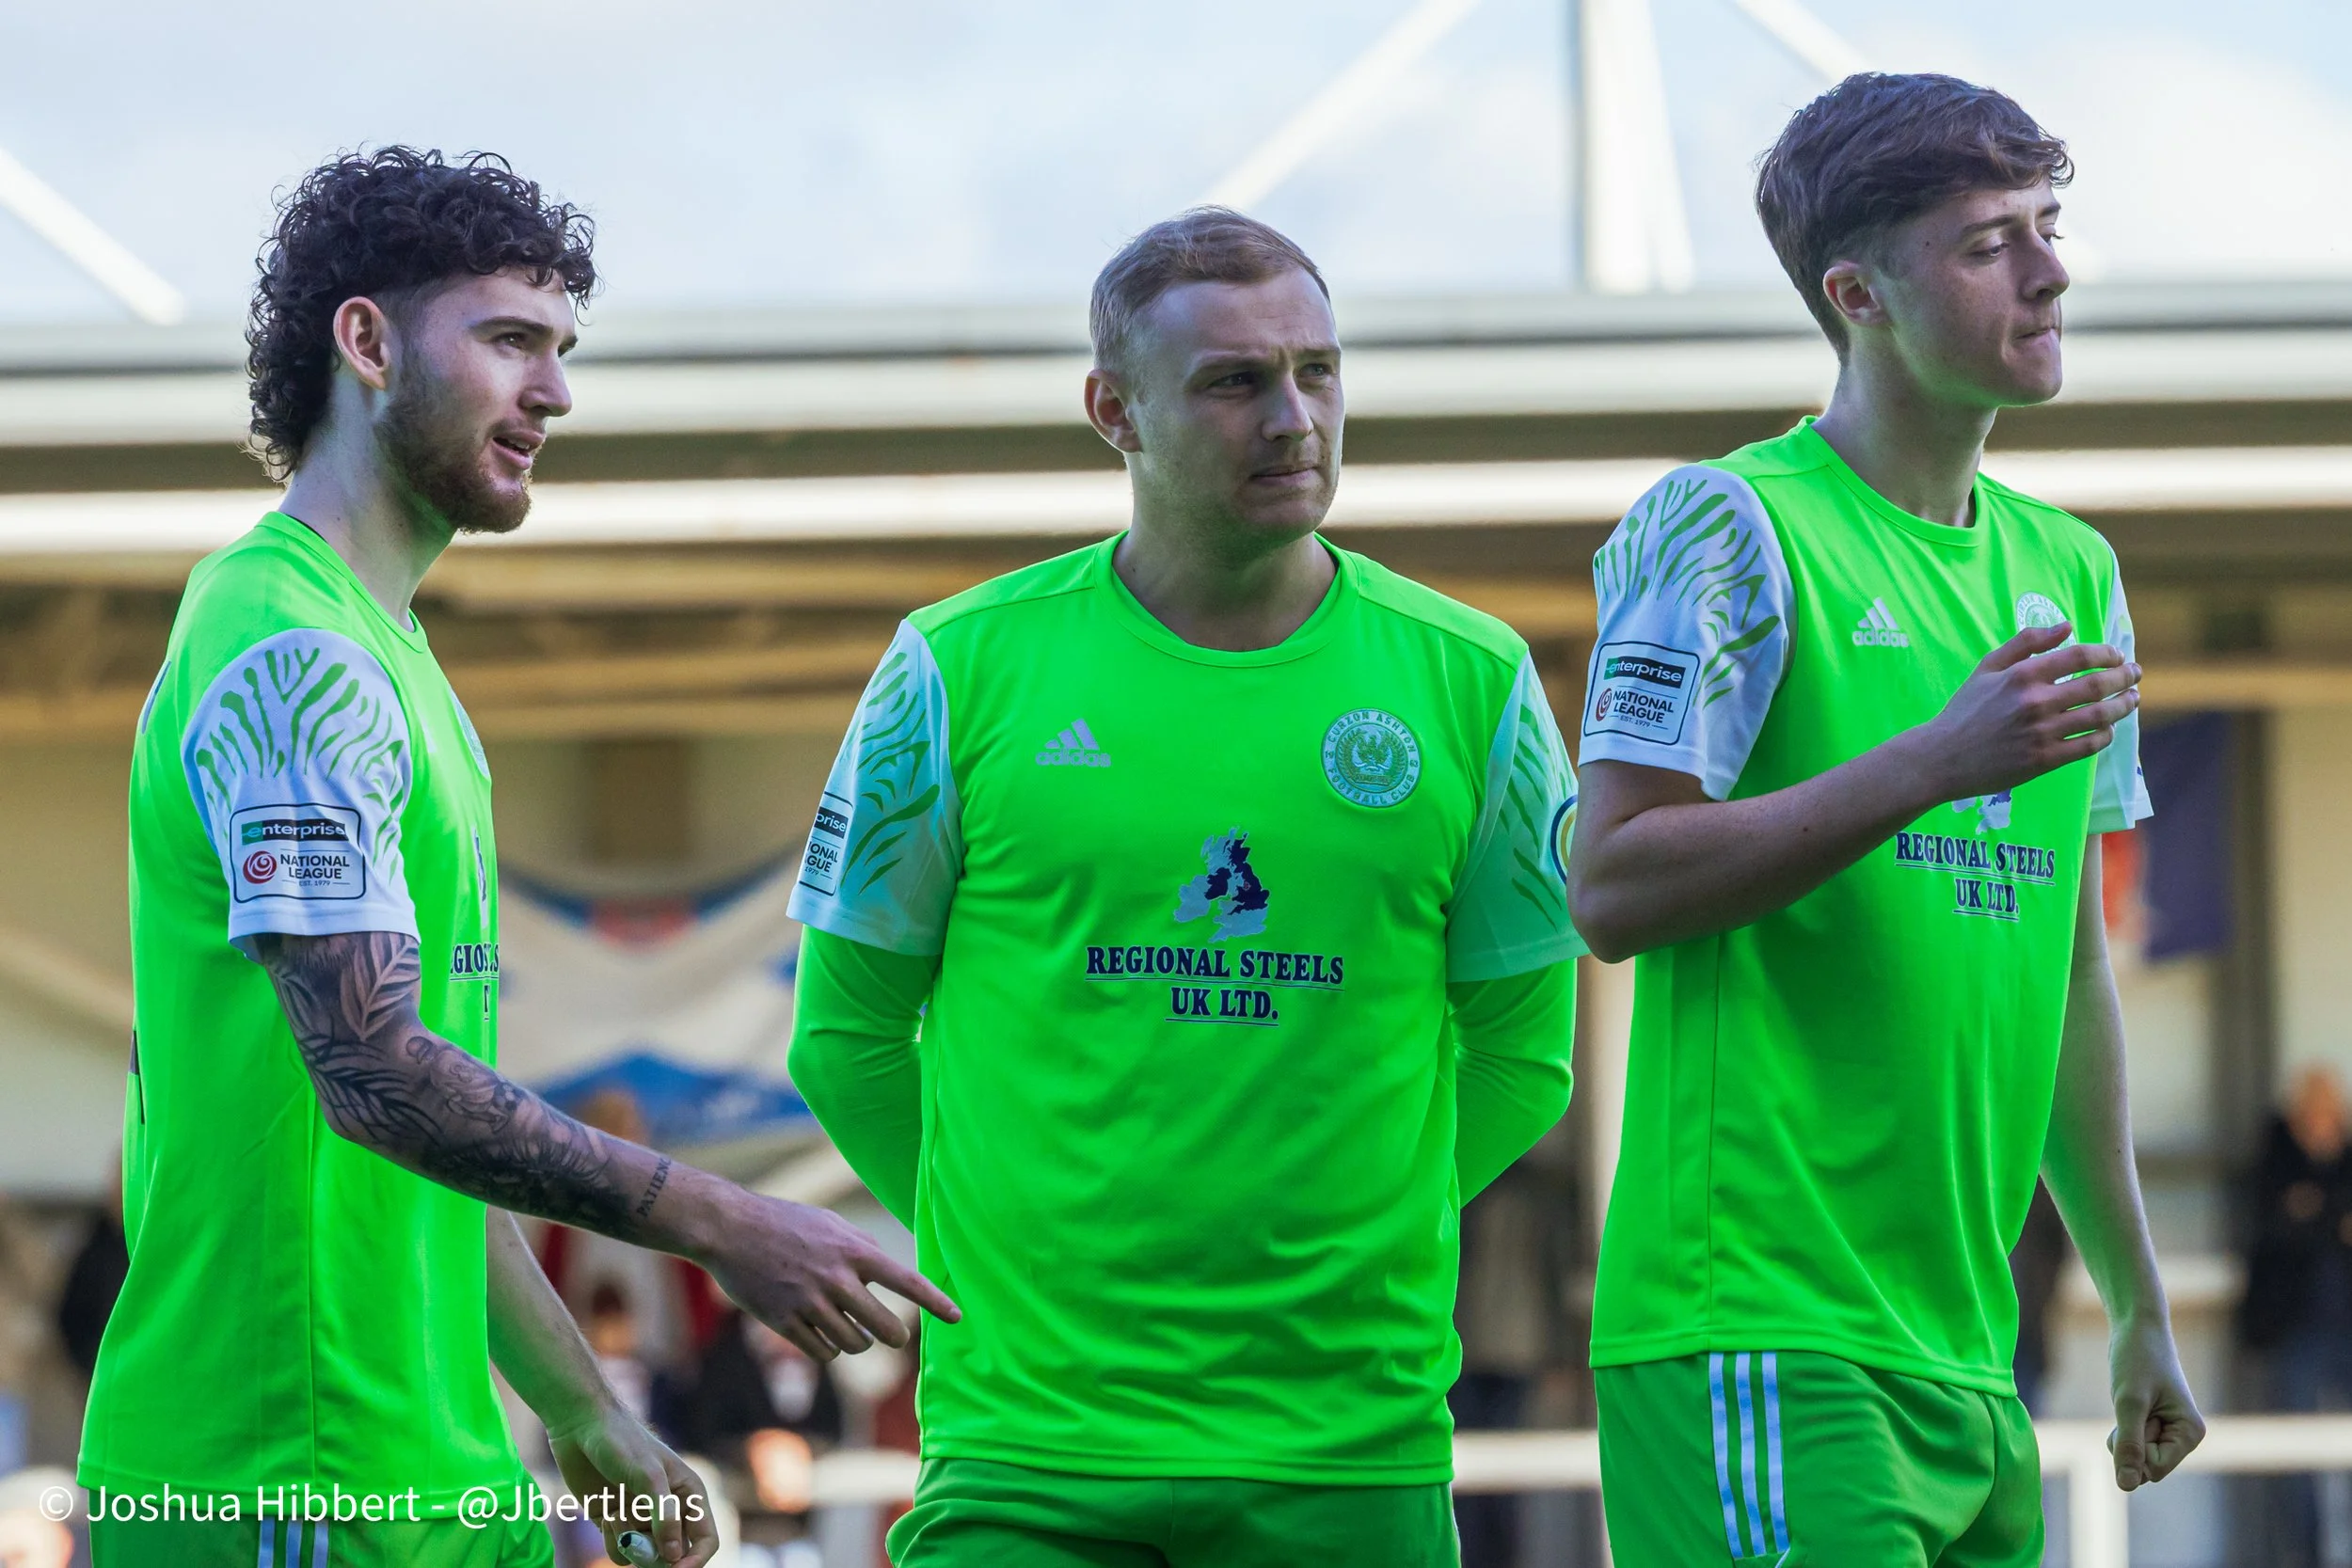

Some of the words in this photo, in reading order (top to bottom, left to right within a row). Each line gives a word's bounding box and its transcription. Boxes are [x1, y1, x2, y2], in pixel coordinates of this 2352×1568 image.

[1852, 627, 1909, 648] adidas
[1605, 660, 1682, 682] enterprise
[1613, 689, 1675, 713] NATIONAL
[1613, 702, 1665, 723] LEAGUE
[1327, 711, 1370, 743] CURZON
[1375, 713, 1417, 752] ASHTON
[1635, 720, 1651, 728] 1979
[1036, 748, 1112, 768] adidas
[1391, 774, 1415, 800] CLUB
[243, 822, 346, 838] enterprise
[279, 853, 350, 867] NATIONAL
[805, 854, 833, 873] GUE
[1895, 832, 1992, 869] REGIONAL
[1994, 842, 2055, 879] STEELS
[288, 867, 342, 879] LEAGUE
[1954, 878, 1982, 909] UK
[1986, 880, 2020, 914] LTD.
[1086, 944, 1231, 978] REGIONAL
[1239, 949, 1344, 985] STEELS
[1169, 987, 1213, 1017] UK
[1219, 989, 1279, 1021] LTD.
